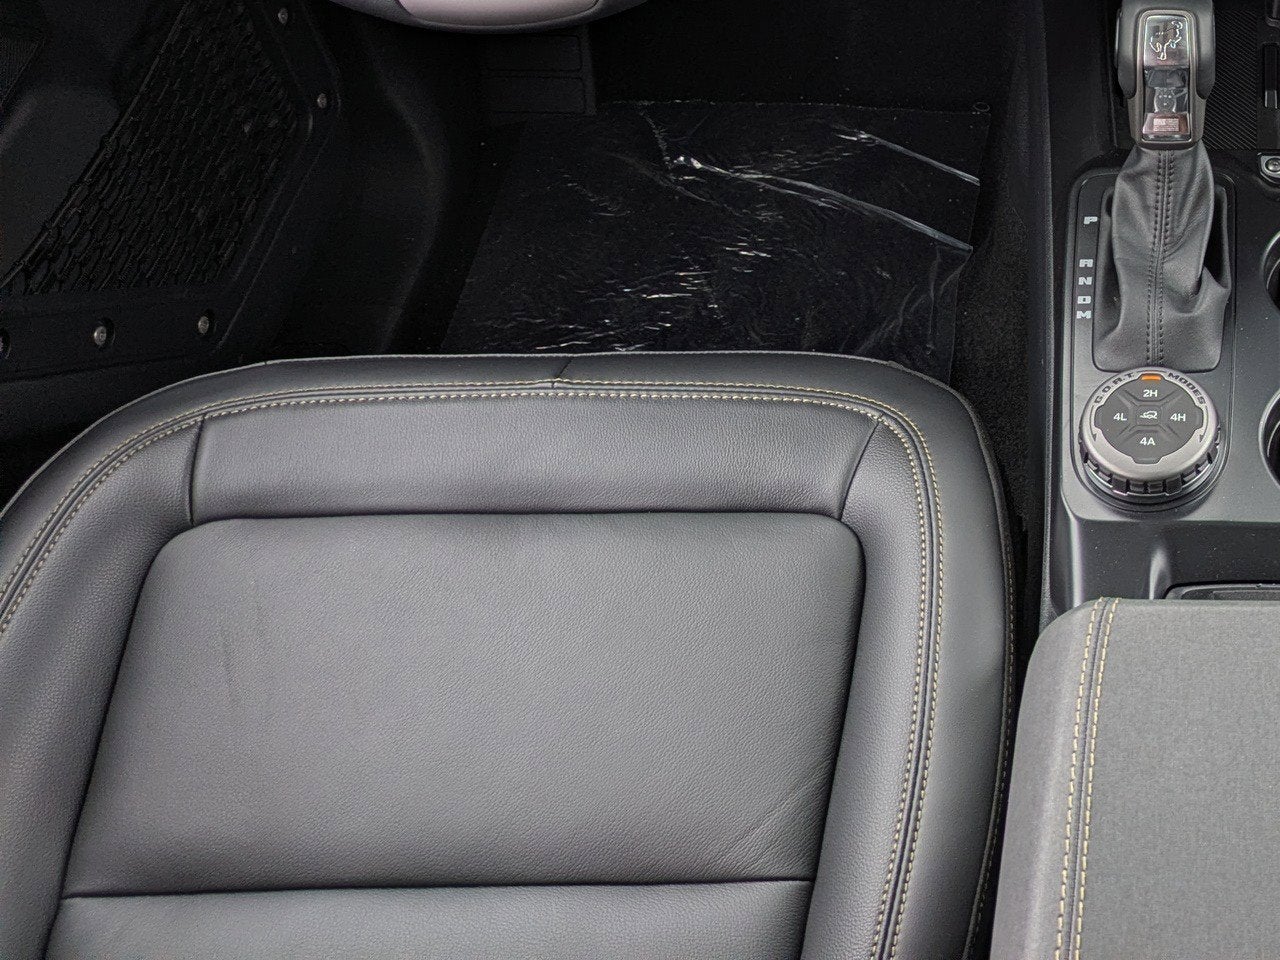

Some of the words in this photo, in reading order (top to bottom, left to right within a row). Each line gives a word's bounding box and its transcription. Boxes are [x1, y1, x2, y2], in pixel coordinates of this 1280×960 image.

[1083, 216, 1098, 225] P
[1078, 276, 1093, 285] N
[1077, 295, 1091, 304] D
[1076, 310, 1092, 319] M
[1167, 372, 1206, 405] MODES
[1142, 389, 1158, 398] 2H
[1113, 412, 1128, 421] 4L
[1169, 413, 1186, 422] 4H
[1139, 436, 1156, 446] 4A
